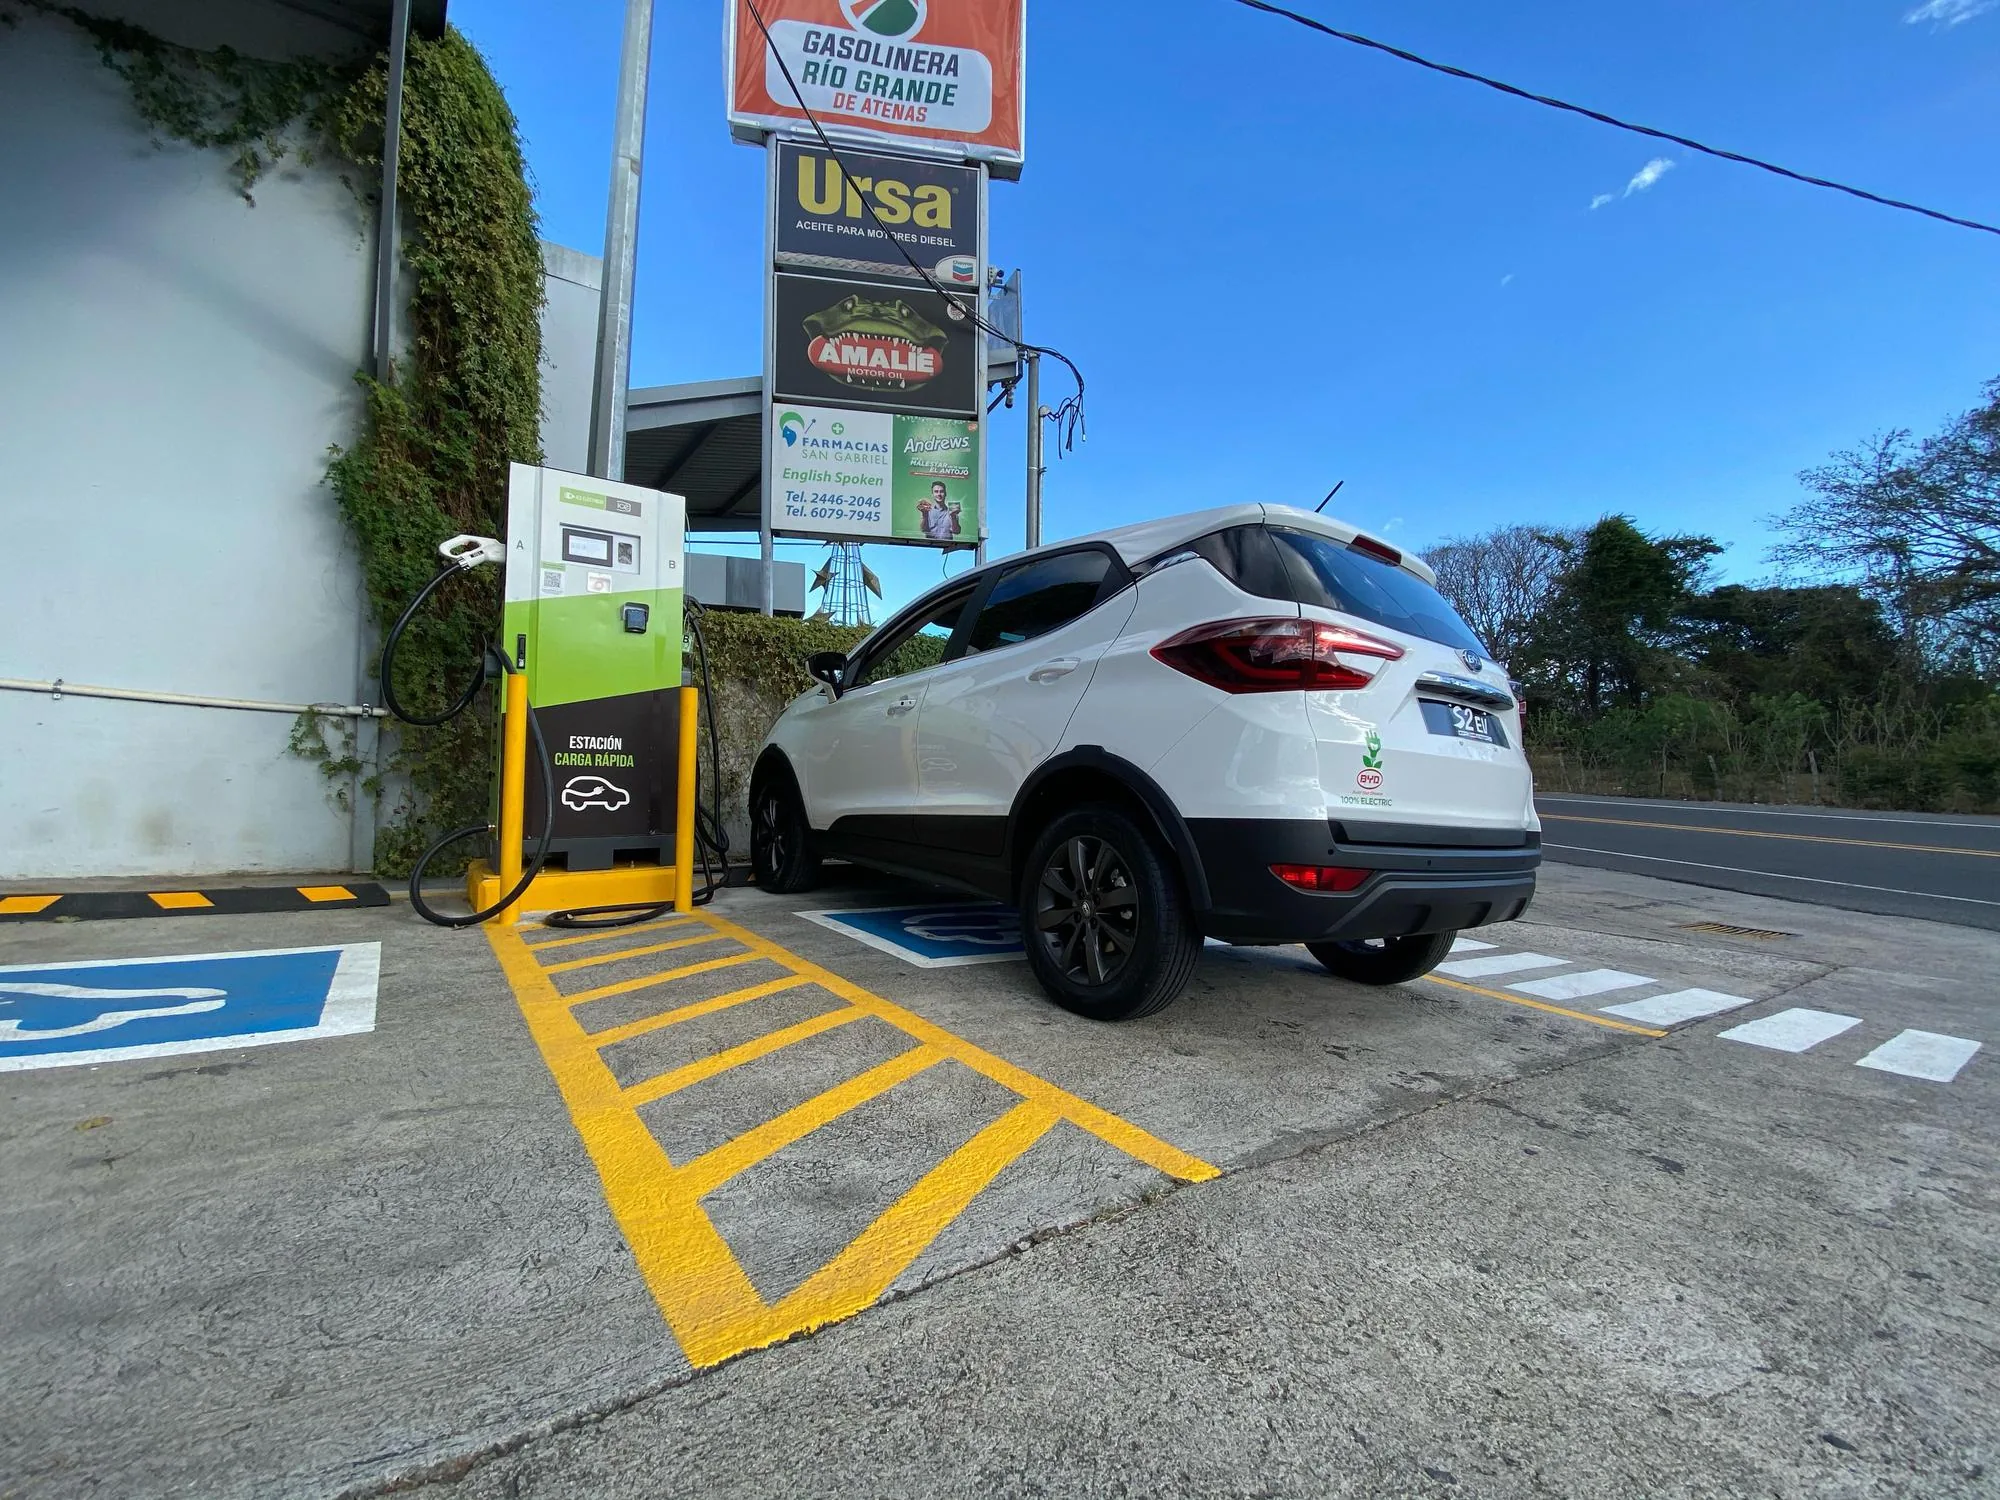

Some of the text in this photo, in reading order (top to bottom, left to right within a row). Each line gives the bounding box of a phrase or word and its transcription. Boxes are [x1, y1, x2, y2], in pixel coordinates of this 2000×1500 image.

[802, 30, 959, 77] GASOLINERA
[802, 60, 959, 107] RÍO GRANDE
[833, 92, 928, 123] DE ATENAS
[798, 156, 952, 229] Ursa
[796, 220, 956, 248] ACEITE PARA MOTORES DIESEL
[818, 342, 934, 373] AMALIE
[847, 367, 905, 380] MOTOR OIL
[802, 437, 889, 453] FARMACIAS
[903, 434, 970, 454] Andrews
[801, 449, 889, 465] SAN GABRIEL
[910, 459, 948, 468] MALESTAR
[783, 468, 884, 487] English Spoken
[940, 468, 969, 476] ANTOJO
[785, 490, 881, 508] Tel. 2446-2046
[785, 505, 881, 522] Tel. 6079-7945
[516, 539, 524, 550] A
[668, 560, 676, 569] B
[682, 634, 690, 643] B
[1474, 715, 1488, 734] EV
[569, 734, 622, 751] ESTACIÓN
[554, 751, 634, 768] CARGA RÁPIDA
[1360, 774, 1380, 784] BYD
[1340, 796, 1393, 807] 100% ELECTRIC
